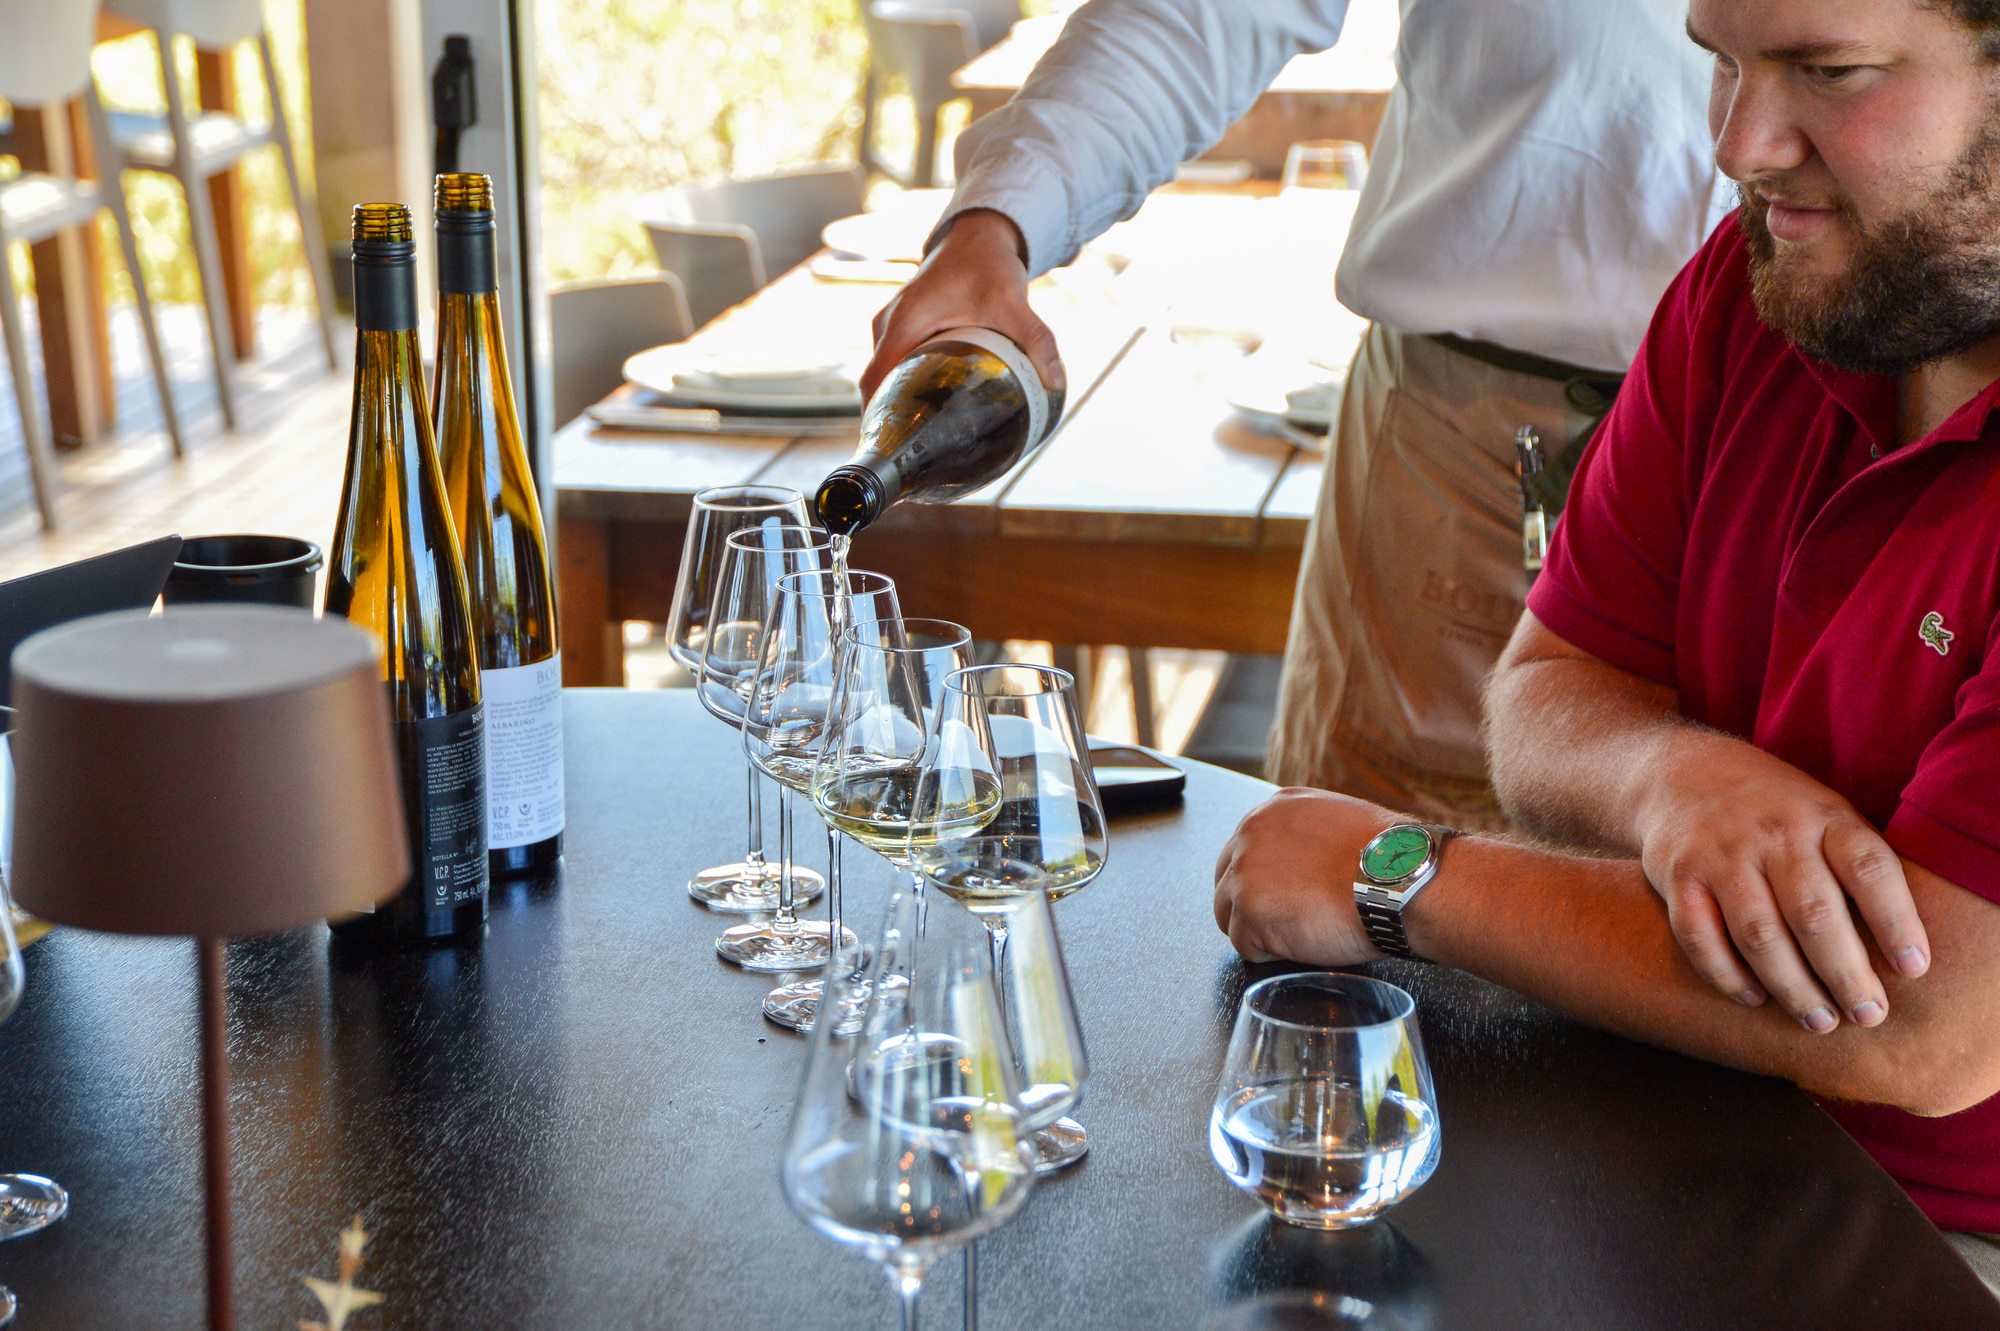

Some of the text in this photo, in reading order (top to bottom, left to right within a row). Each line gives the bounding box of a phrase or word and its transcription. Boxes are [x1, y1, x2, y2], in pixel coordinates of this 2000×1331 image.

[490, 718, 536, 729] ALBARIÑO
[432, 853, 453, 861] BOTELLA
[434, 865, 450, 880] V.C.P.
